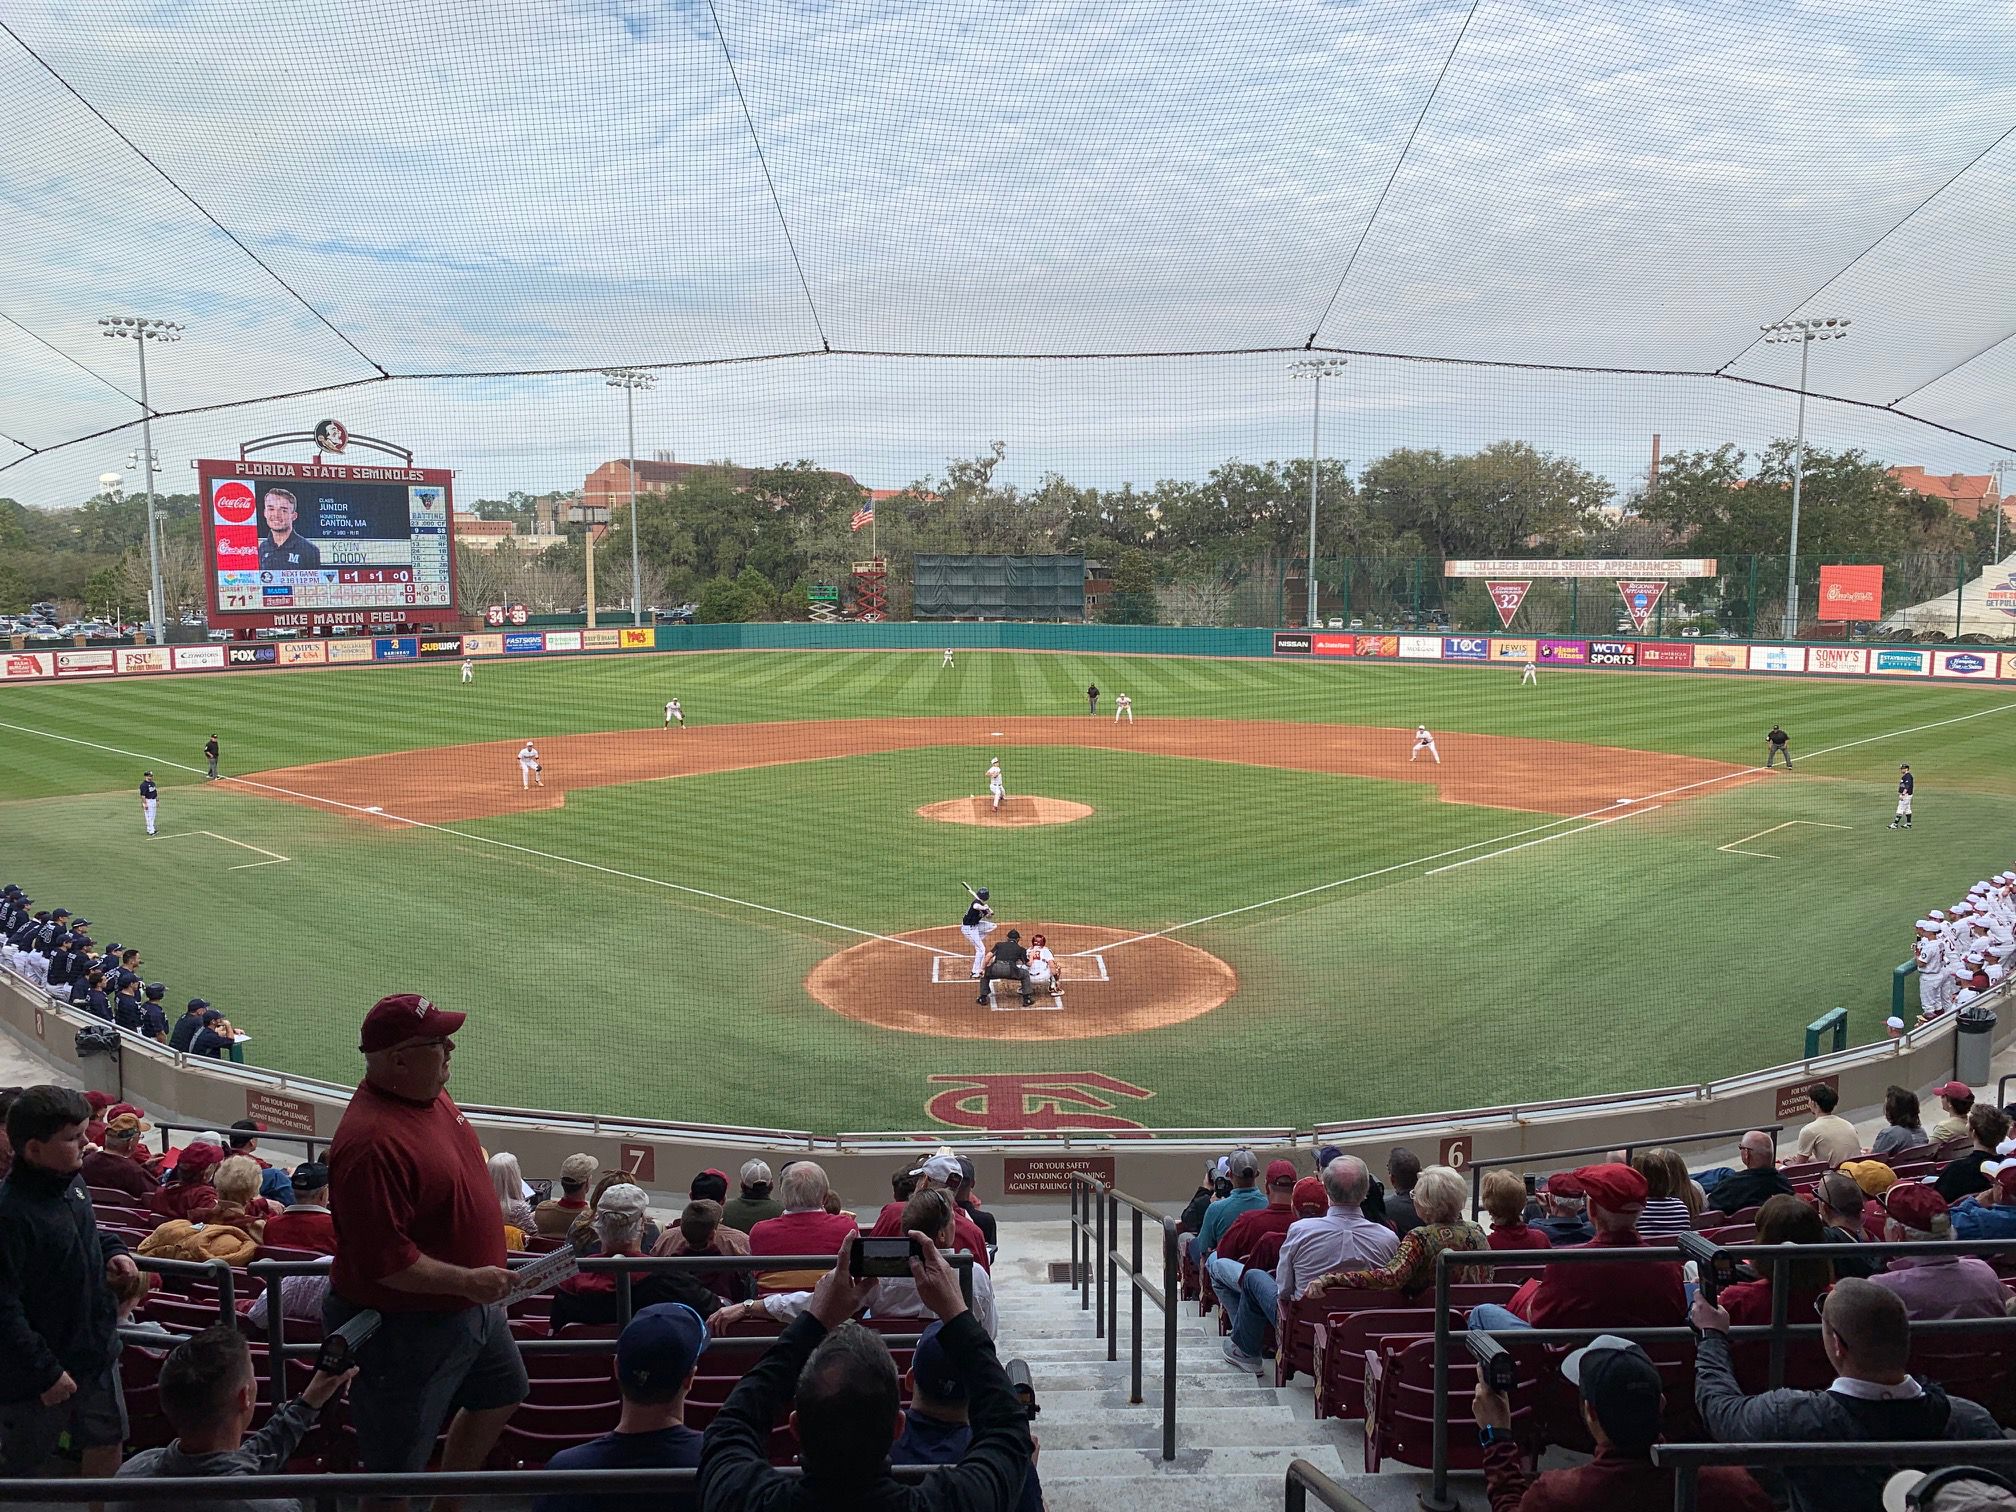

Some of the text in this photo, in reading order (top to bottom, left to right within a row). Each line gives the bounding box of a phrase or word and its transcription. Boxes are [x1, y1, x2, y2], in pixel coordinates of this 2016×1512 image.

[236, 464, 424, 480] FLORIDA STATE SEMINOLES
[320, 519, 353, 527] CANTON,
[332, 542, 359, 552] KEVIN
[333, 552, 367, 564] DOODY
[1474, 561, 1682, 570] COLLEGE WORLD SERIES APPEARANCES
[351, 571, 358, 582] 1
[376, 571, 382, 582] 1
[1499, 595, 1518, 608] 32
[490, 612, 503, 624] 34
[513, 611, 526, 622] 39
[1634, 608, 1647, 617] 56
[274, 612, 406, 625] MIKE MARTIN FIELD
[285, 644, 319, 652] CAMPUS
[421, 641, 460, 652] SUBWAY
[1451, 640, 1482, 651] TOC
[1500, 644, 1526, 655] LEWIS
[1593, 644, 1625, 653] WCTV
[125, 653, 152, 664] FSU
[230, 650, 256, 661] FOX
[1591, 654, 1634, 664] SPORTS
[1816, 650, 1860, 662] SONNY'S
[37, 1013, 42, 1034] 8
[261, 1096, 299, 1110] FOR YOUR SAFETY
[260, 1104, 282, 1116] STANDING
[290, 1112, 309, 1122] LEANING
[1778, 1106, 1796, 1116] AGAINST
[249, 1111, 267, 1119] AGAINST
[268, 1115, 285, 1125] RAILING
[293, 1122, 312, 1131] NETTING
[1448, 1142, 1463, 1168] 6
[630, 1150, 645, 1174] 7
